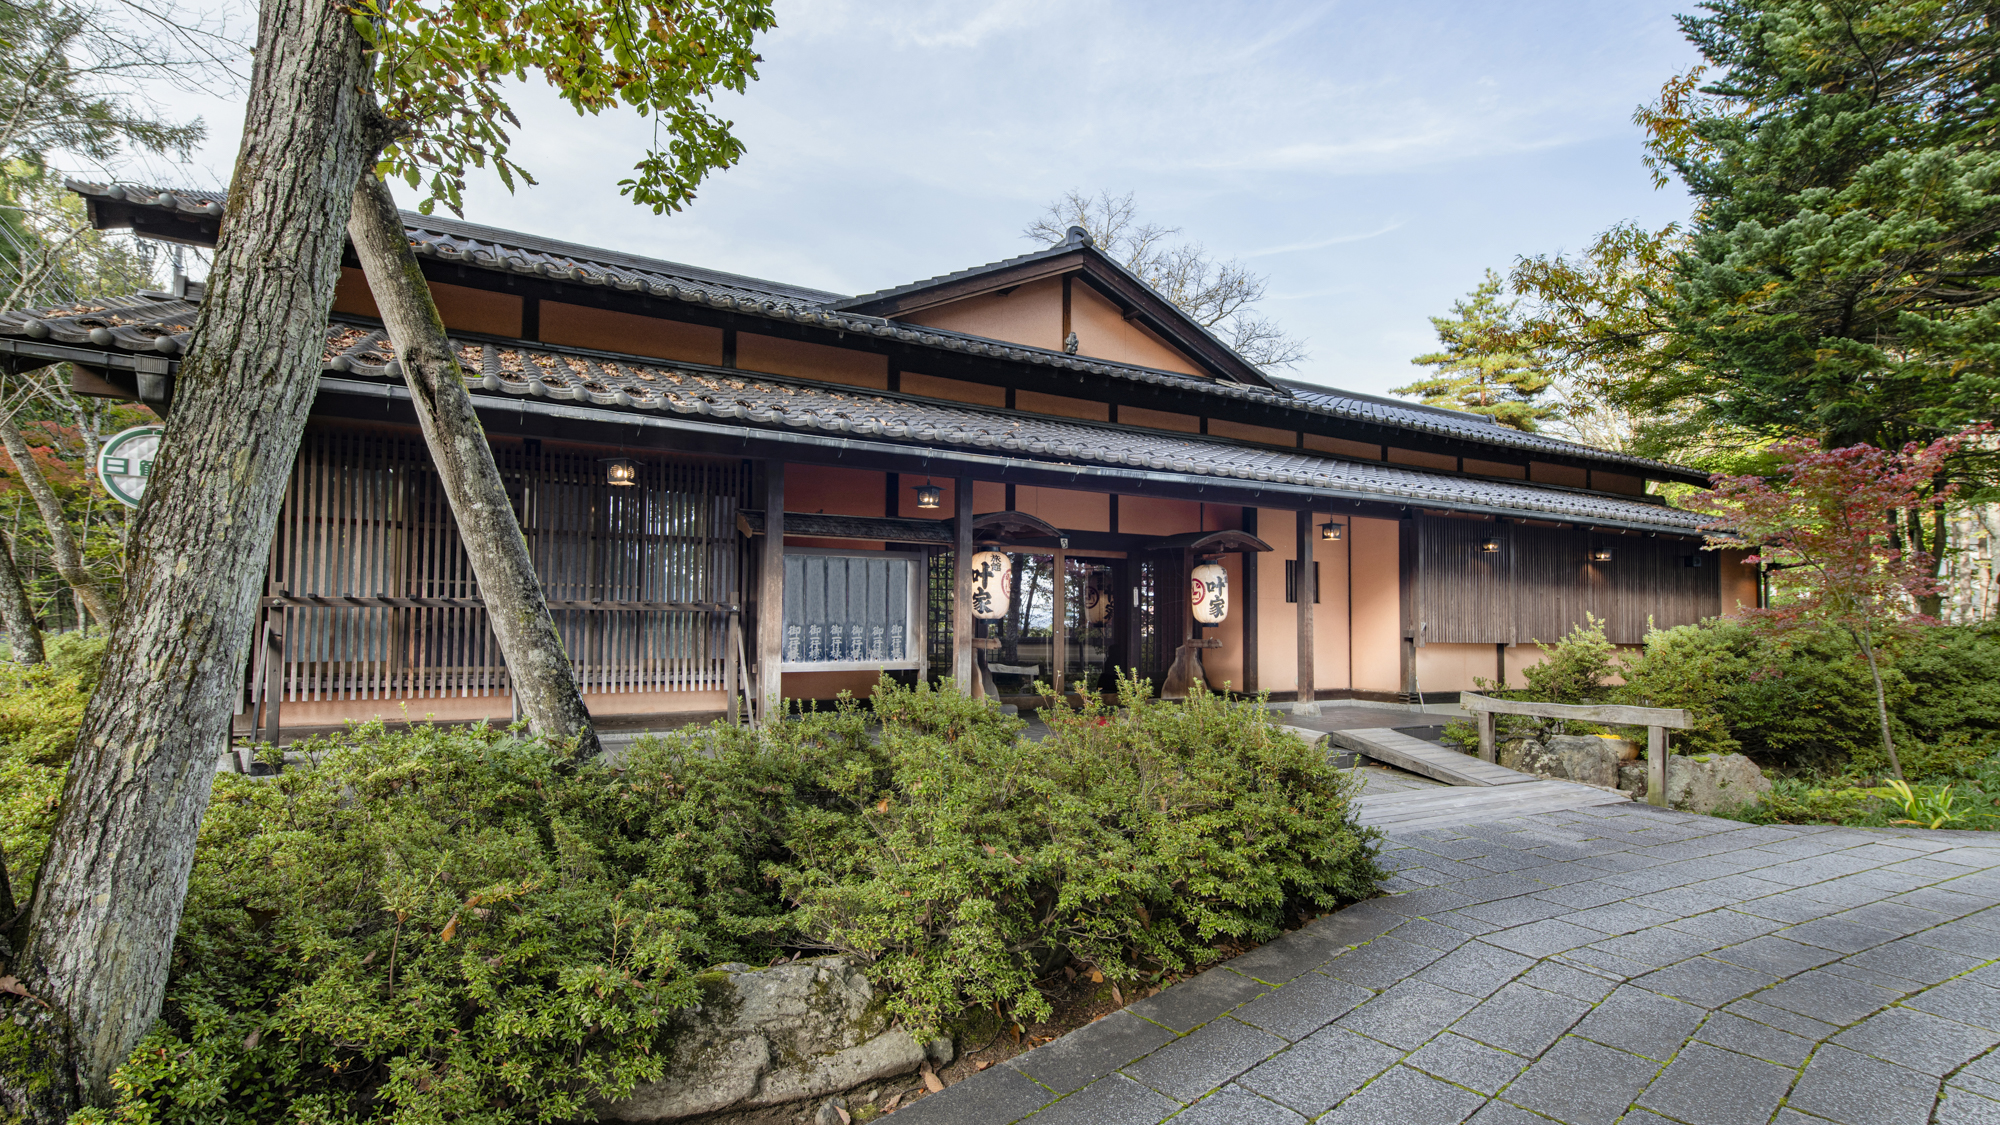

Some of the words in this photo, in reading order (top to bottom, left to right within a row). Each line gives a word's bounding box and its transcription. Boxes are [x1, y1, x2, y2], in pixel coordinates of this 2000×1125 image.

[990, 554, 1002, 571] 旅館
[972, 561, 994, 614] 叶家
[1205, 576, 1225, 618] 叶家
